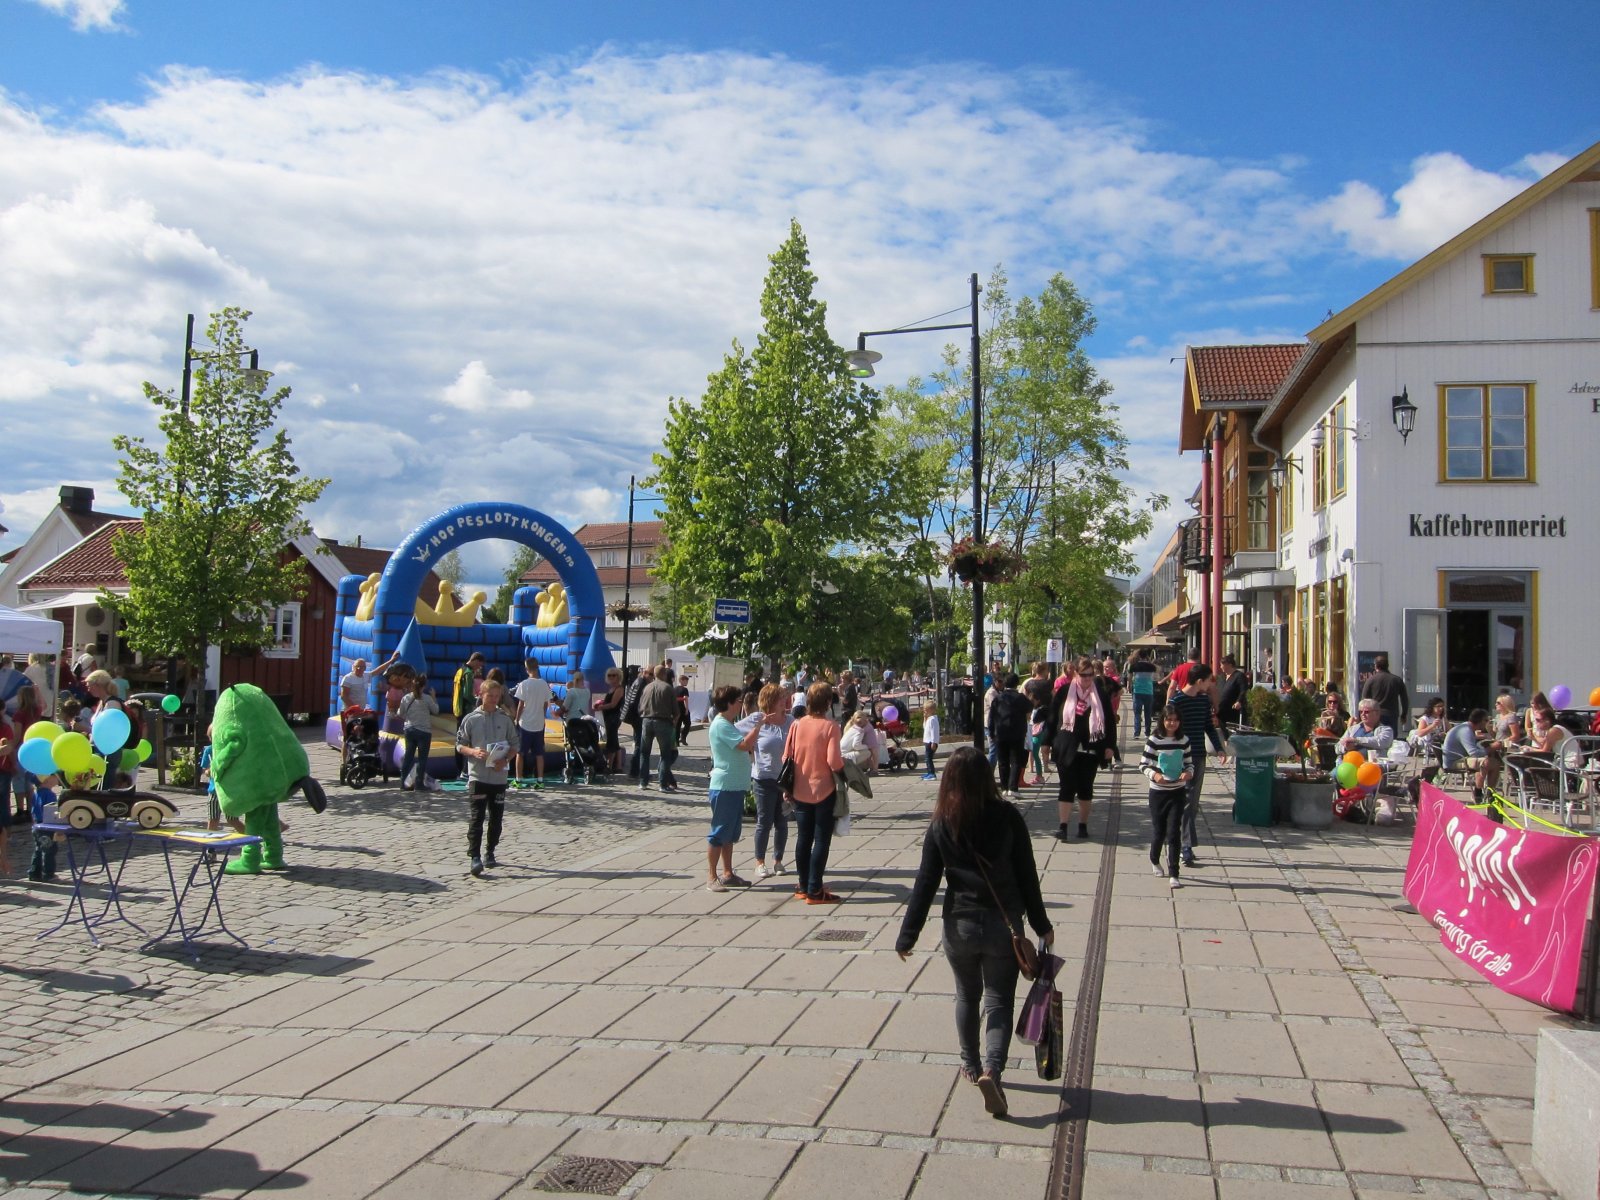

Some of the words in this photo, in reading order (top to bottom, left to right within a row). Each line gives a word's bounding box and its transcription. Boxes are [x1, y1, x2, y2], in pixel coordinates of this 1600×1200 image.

[1409, 513, 1567, 538] Kaffebrenneriet
[1468, 939, 1495, 963] for
[1484, 952, 1513, 977] alle
